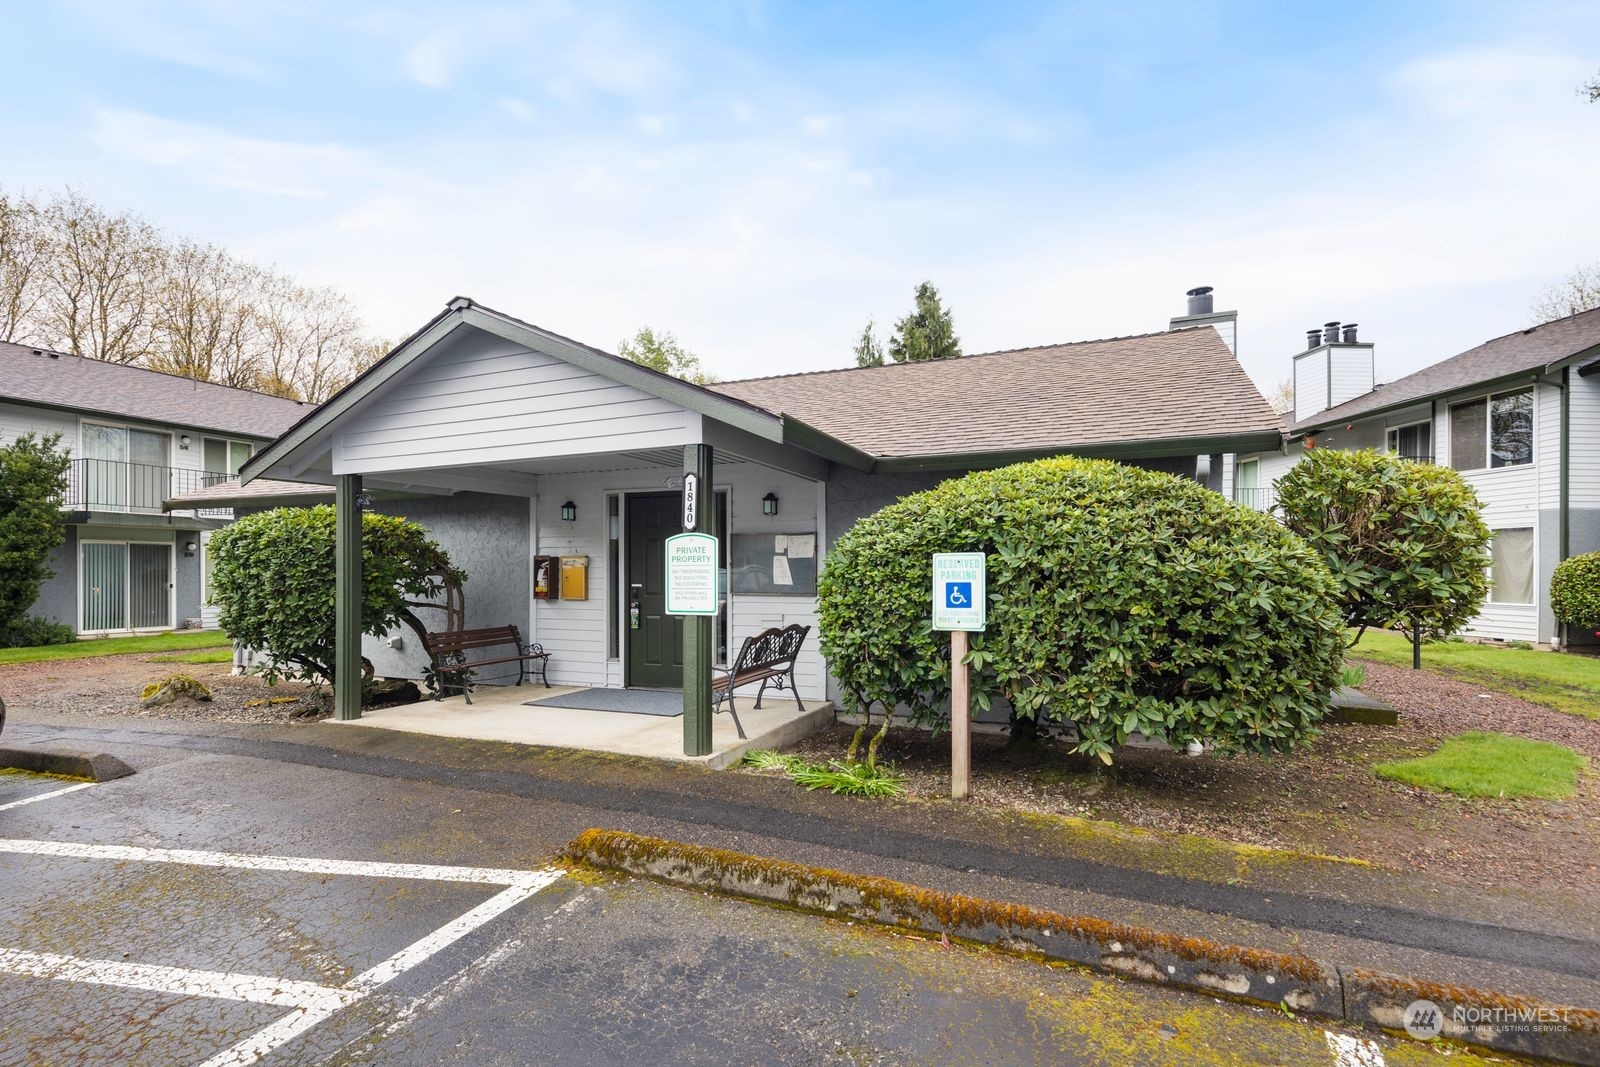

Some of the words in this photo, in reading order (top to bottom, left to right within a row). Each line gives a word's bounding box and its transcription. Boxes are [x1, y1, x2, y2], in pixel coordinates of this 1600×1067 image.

[676, 546, 707, 554] PRIVATE
[671, 555, 711, 563] PROPERTY
[937, 559, 980, 569] RESERVED
[940, 570, 977, 580] PARKING
